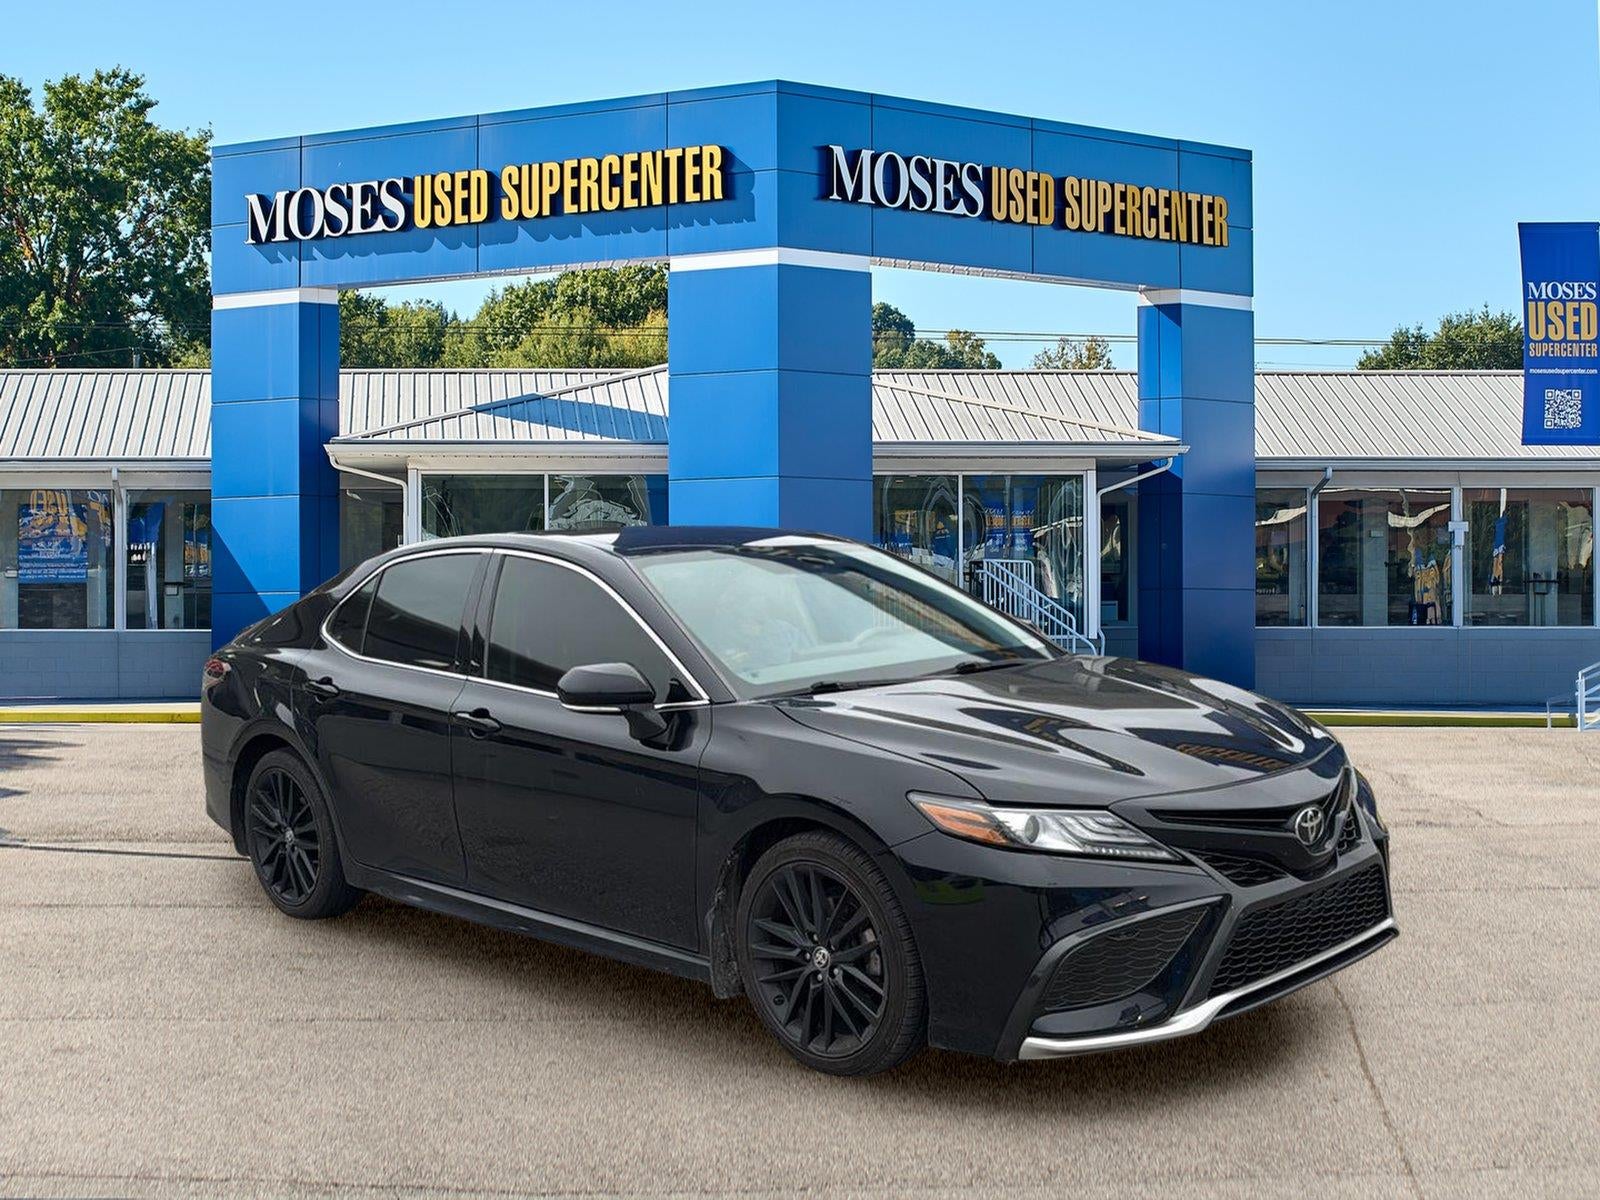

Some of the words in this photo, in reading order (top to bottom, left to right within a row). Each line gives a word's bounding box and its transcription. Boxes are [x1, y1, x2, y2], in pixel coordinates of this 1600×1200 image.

[245, 178, 407, 244] MOSES
[413, 169, 489, 229] USED
[500, 144, 725, 220] SUPERCENTER
[828, 144, 984, 218] MOSES
[991, 166, 1055, 226] USED
[1065, 175, 1230, 247] SUPERCENTER
[1527, 281, 1597, 300] MOSES
[1528, 301, 1598, 341] USED
[1529, 342, 1598, 358] SUPERCENTER
